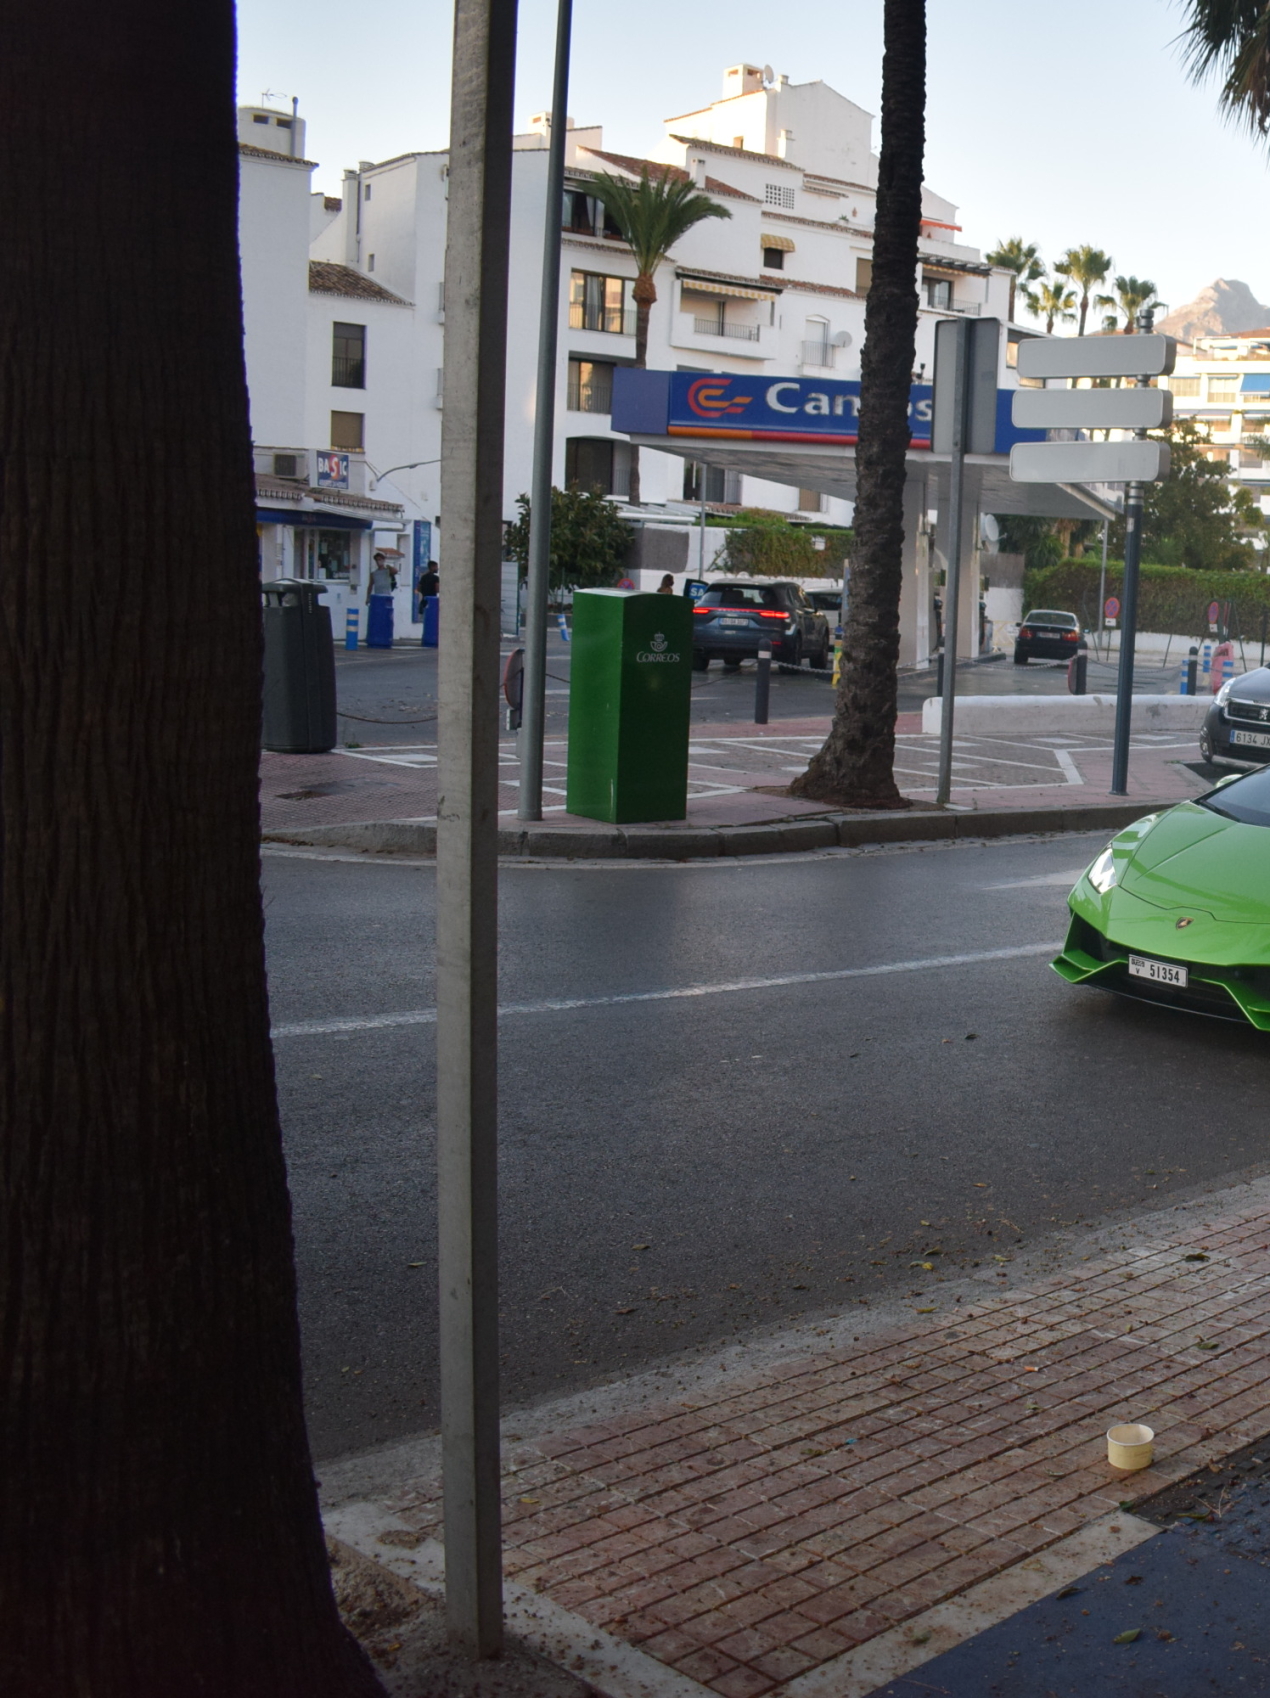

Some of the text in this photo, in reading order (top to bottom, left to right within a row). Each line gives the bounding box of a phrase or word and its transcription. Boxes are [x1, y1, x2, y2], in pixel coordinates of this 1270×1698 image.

[317, 457, 347, 477] BASIC
[636, 651, 680, 663] CORREOS
[1236, 732, 1257, 744] 6134
[1149, 964, 1180, 983] 51354
